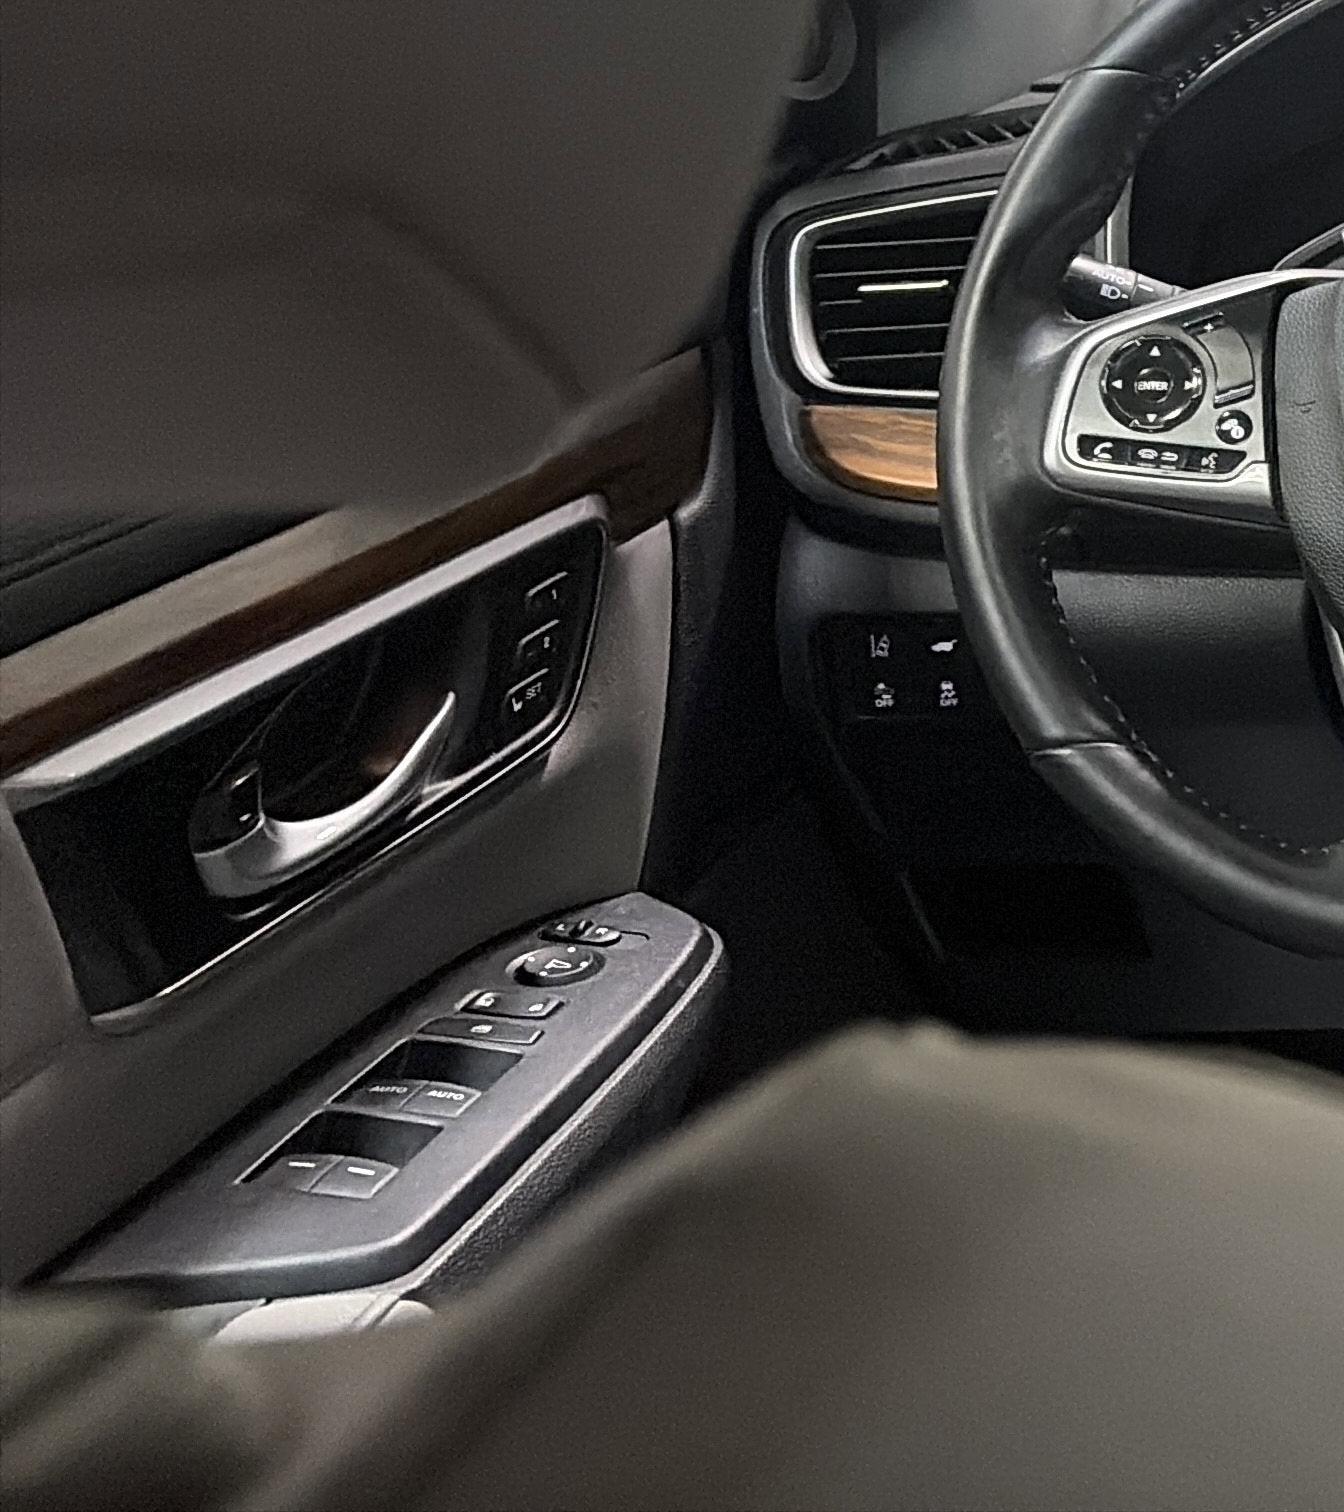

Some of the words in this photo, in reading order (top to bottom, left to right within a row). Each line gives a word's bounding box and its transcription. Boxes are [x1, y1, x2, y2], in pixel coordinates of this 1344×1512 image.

[1137, 380, 1168, 392] ENTER
[875, 698, 895, 708] OFF
[369, 1085, 408, 1094] AUTO
[426, 1089, 465, 1101] AUTO
